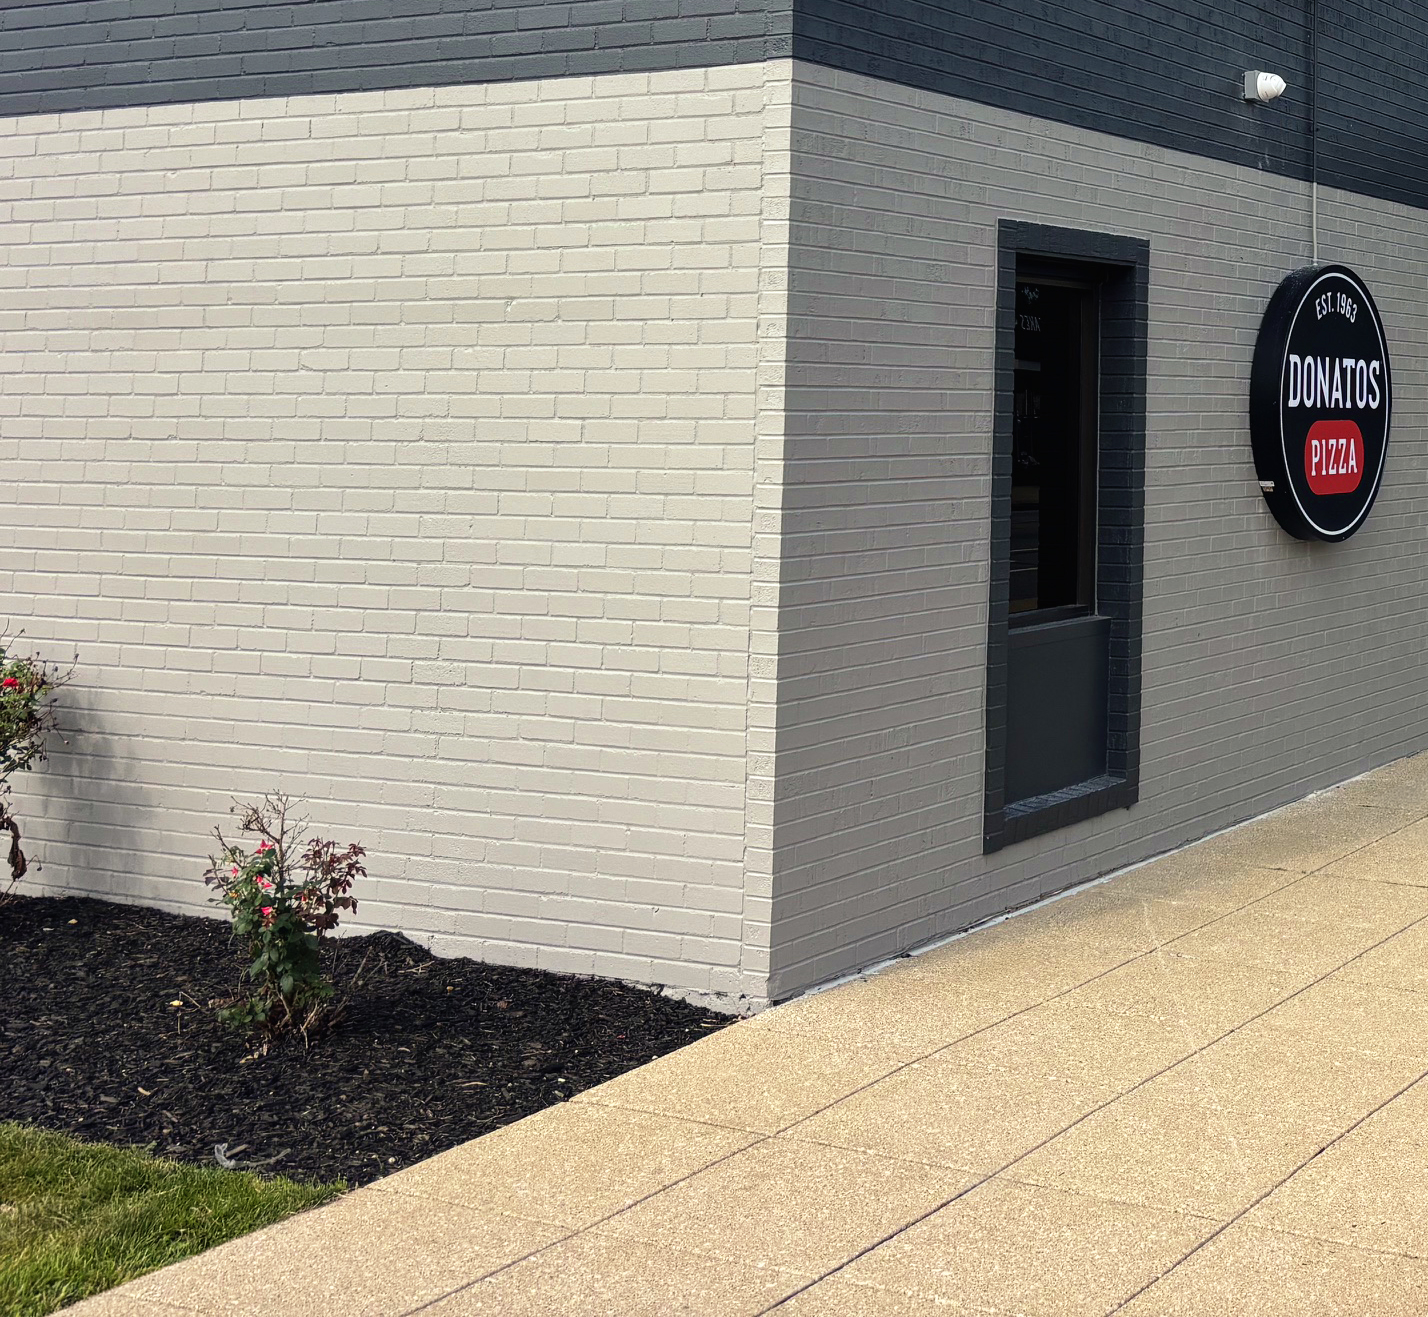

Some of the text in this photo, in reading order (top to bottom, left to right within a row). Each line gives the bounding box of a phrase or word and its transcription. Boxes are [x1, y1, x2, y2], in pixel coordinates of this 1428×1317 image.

[1315, 291, 1358, 323] EST. 1963
[1288, 354, 1381, 410] DONATOS
[1311, 438, 1358, 477] PIZZA
